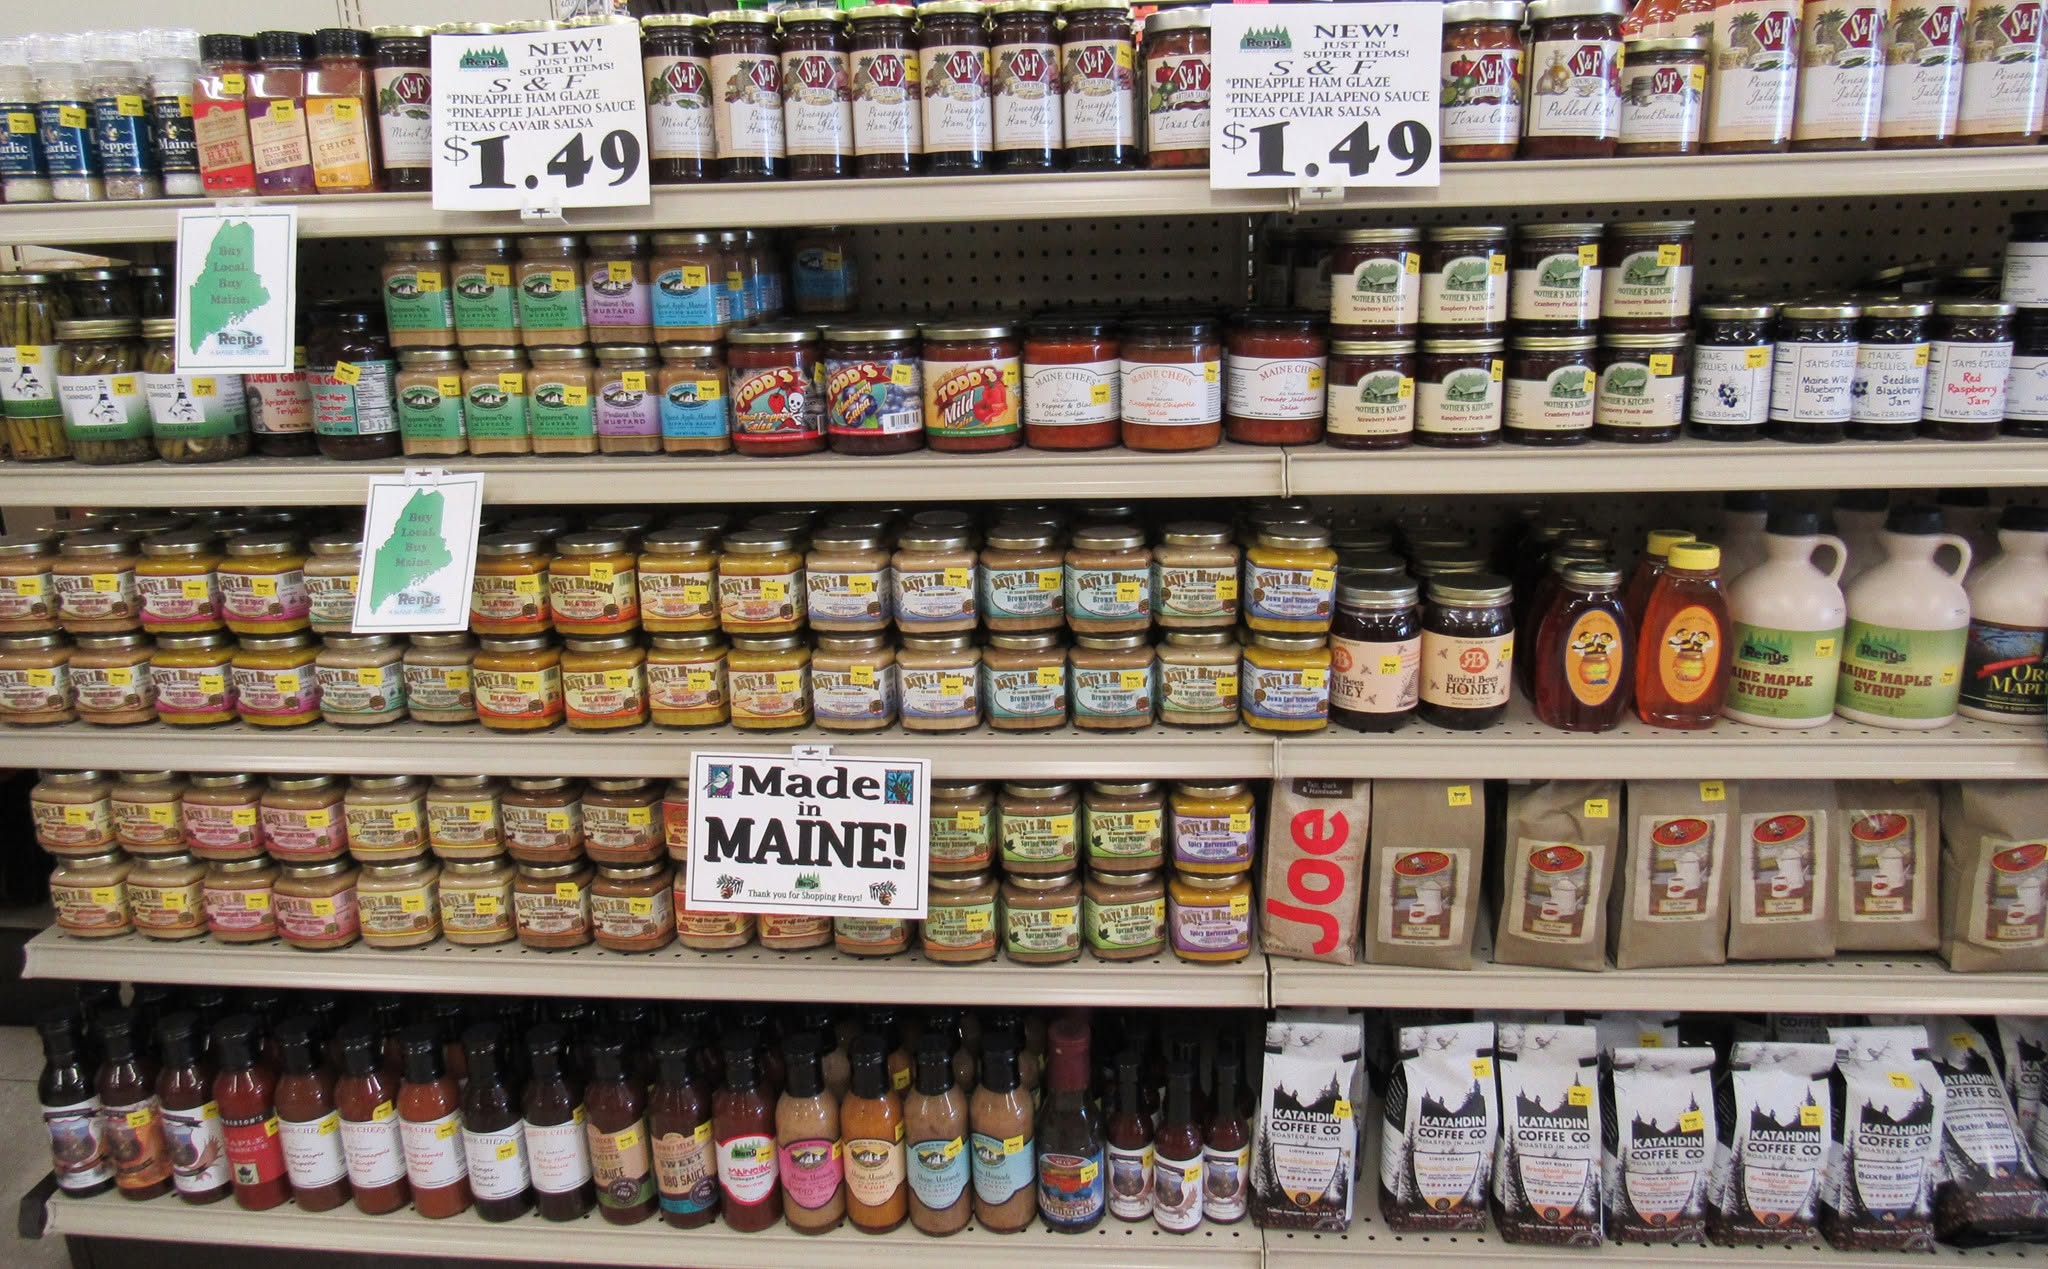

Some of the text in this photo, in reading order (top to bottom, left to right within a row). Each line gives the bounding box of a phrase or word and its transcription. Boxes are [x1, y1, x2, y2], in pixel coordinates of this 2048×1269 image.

[2010, 9, 2038, 38] S&F
[1313, 24, 1399, 39] NEW!
[528, 38, 603, 56] NEW!
[1321, 41, 1386, 50] JUST IN!
[536, 55, 593, 67] JUST IN!
[1084, 50, 1106, 74] S&F
[1303, 51, 1352, 59] SUPER
[519, 66, 560, 76] SUPER
[564, 62, 615, 74] ITEMS!
[953, 54, 974, 78] S&F
[1018, 52, 1040, 77] S&F
[1269, 60, 1377, 76] S & F
[1575, 50, 1602, 75] S&F
[675, 66, 696, 88] S&F
[757, 64, 776, 87] S&F
[804, 61, 826, 83] S&F
[876, 59, 896, 82] S&F
[1179, 64, 1204, 90] S&F
[1479, 59, 1504, 85] S&F
[402, 74, 424, 99] S&F
[488, 73, 586, 93] S & F
[1309, 78, 1341, 88] HAM
[1346, 77, 1391, 88] GLAZE
[1654, 71, 1677, 93] S&F
[526, 91, 556, 103] HAM
[560, 89, 600, 101] GLAZE
[1308, 92, 1380, 104] JALAPENO
[1384, 91, 1430, 102] SAUCE
[526, 103, 592, 119] JALAPENO
[595, 100, 635, 113] SAUCE
[1279, 107, 1333, 117] CAVIAR
[1338, 107, 1381, 117] SALSA
[1546, 100, 1587, 117] Pulled
[500, 119, 549, 131] CAVAIR
[554, 118, 594, 129] SALSA
[660, 116, 689, 129] Mint
[1073, 113, 1094, 124] Ham
[392, 126, 421, 140] Mint
[100, 140, 136, 154] Pepper
[319, 139, 356, 152] CHICK
[1222, 120, 1432, 177] $1.49
[443, 129, 640, 189] $1.49
[219, 246, 242, 256] Buy
[214, 263, 248, 272] Local.
[219, 278, 242, 288] Buy
[210, 295, 250, 305] Maine.
[218, 332, 263, 349] Renys
[1867, 351, 1901, 360] MAINE
[1130, 371, 1193, 385] MAINE CHEFS
[1259, 365, 1295, 381] MAINE
[1882, 374, 1920, 385] Seedless
[1963, 372, 1981, 382] Red
[737, 369, 793, 406] TODD'S
[828, 362, 879, 400] TODD'S
[938, 368, 997, 399] TODD'S
[1034, 373, 1096, 389] MAINE CHEFS
[1802, 376, 1848, 385] Maine Wild
[1804, 385, 1845, 396] Blueberry
[1875, 386, 1920, 397] Blackberry
[1948, 384, 1997, 397] Raspberry
[1816, 394, 1835, 403] Jam
[1889, 397, 1911, 406] Jam
[1967, 397, 1990, 405] Jam
[846, 396, 872, 426] Salsa
[944, 391, 975, 427] Mild
[1441, 403, 1494, 412] MOTHER'S KITCHEN
[408, 513, 433, 522] Buy
[401, 528, 436, 537] Local.
[406, 542, 427, 551] Buy
[396, 558, 432, 567] Maine.
[398, 592, 440, 609] Renys
[1744, 643, 1789, 665] Renys
[1860, 642, 1907, 663] Renys
[1447, 674, 1499, 684] Royal Bees
[1764, 673, 1813, 687] MAPLE
[1881, 672, 1932, 687] MAPLE
[1446, 682, 1498, 695] HONEY
[1738, 681, 1789, 700] SYRUP
[1854, 681, 1906, 700] SYRUP
[738, 765, 880, 800] Made
[797, 801, 822, 817] in
[704, 816, 907, 870] MAINE!
[1266, 808, 1349, 955] Joe
[748, 890, 863, 902] Thank you for Shopping Renys!
[1274, 1108, 1340, 1124] KATAHDIN
[1420, 1116, 1486, 1128] KATAHDIN
[1519, 1116, 1588, 1129] KATAHDIN
[1272, 1122, 1341, 1135] COFFEE CO
[1418, 1128, 1487, 1139] COFFEE CO
[1861, 1122, 1931, 1135] KATAHDIN
[1518, 1131, 1590, 1143] COFFEE CO
[1634, 1136, 1703, 1149] KATAHDIN
[1751, 1130, 1820, 1143] KATAHDIN
[1859, 1136, 1932, 1148] COFFEE CO
[1632, 1149, 1704, 1160] COFFEE CO
[1747, 1143, 1821, 1155] COFFEE CO
[660, 1153, 702, 1169] SWEET
[664, 1167, 706, 1188] BBQ SAUCE
[1858, 1172, 1922, 1181] Baxter Blend
